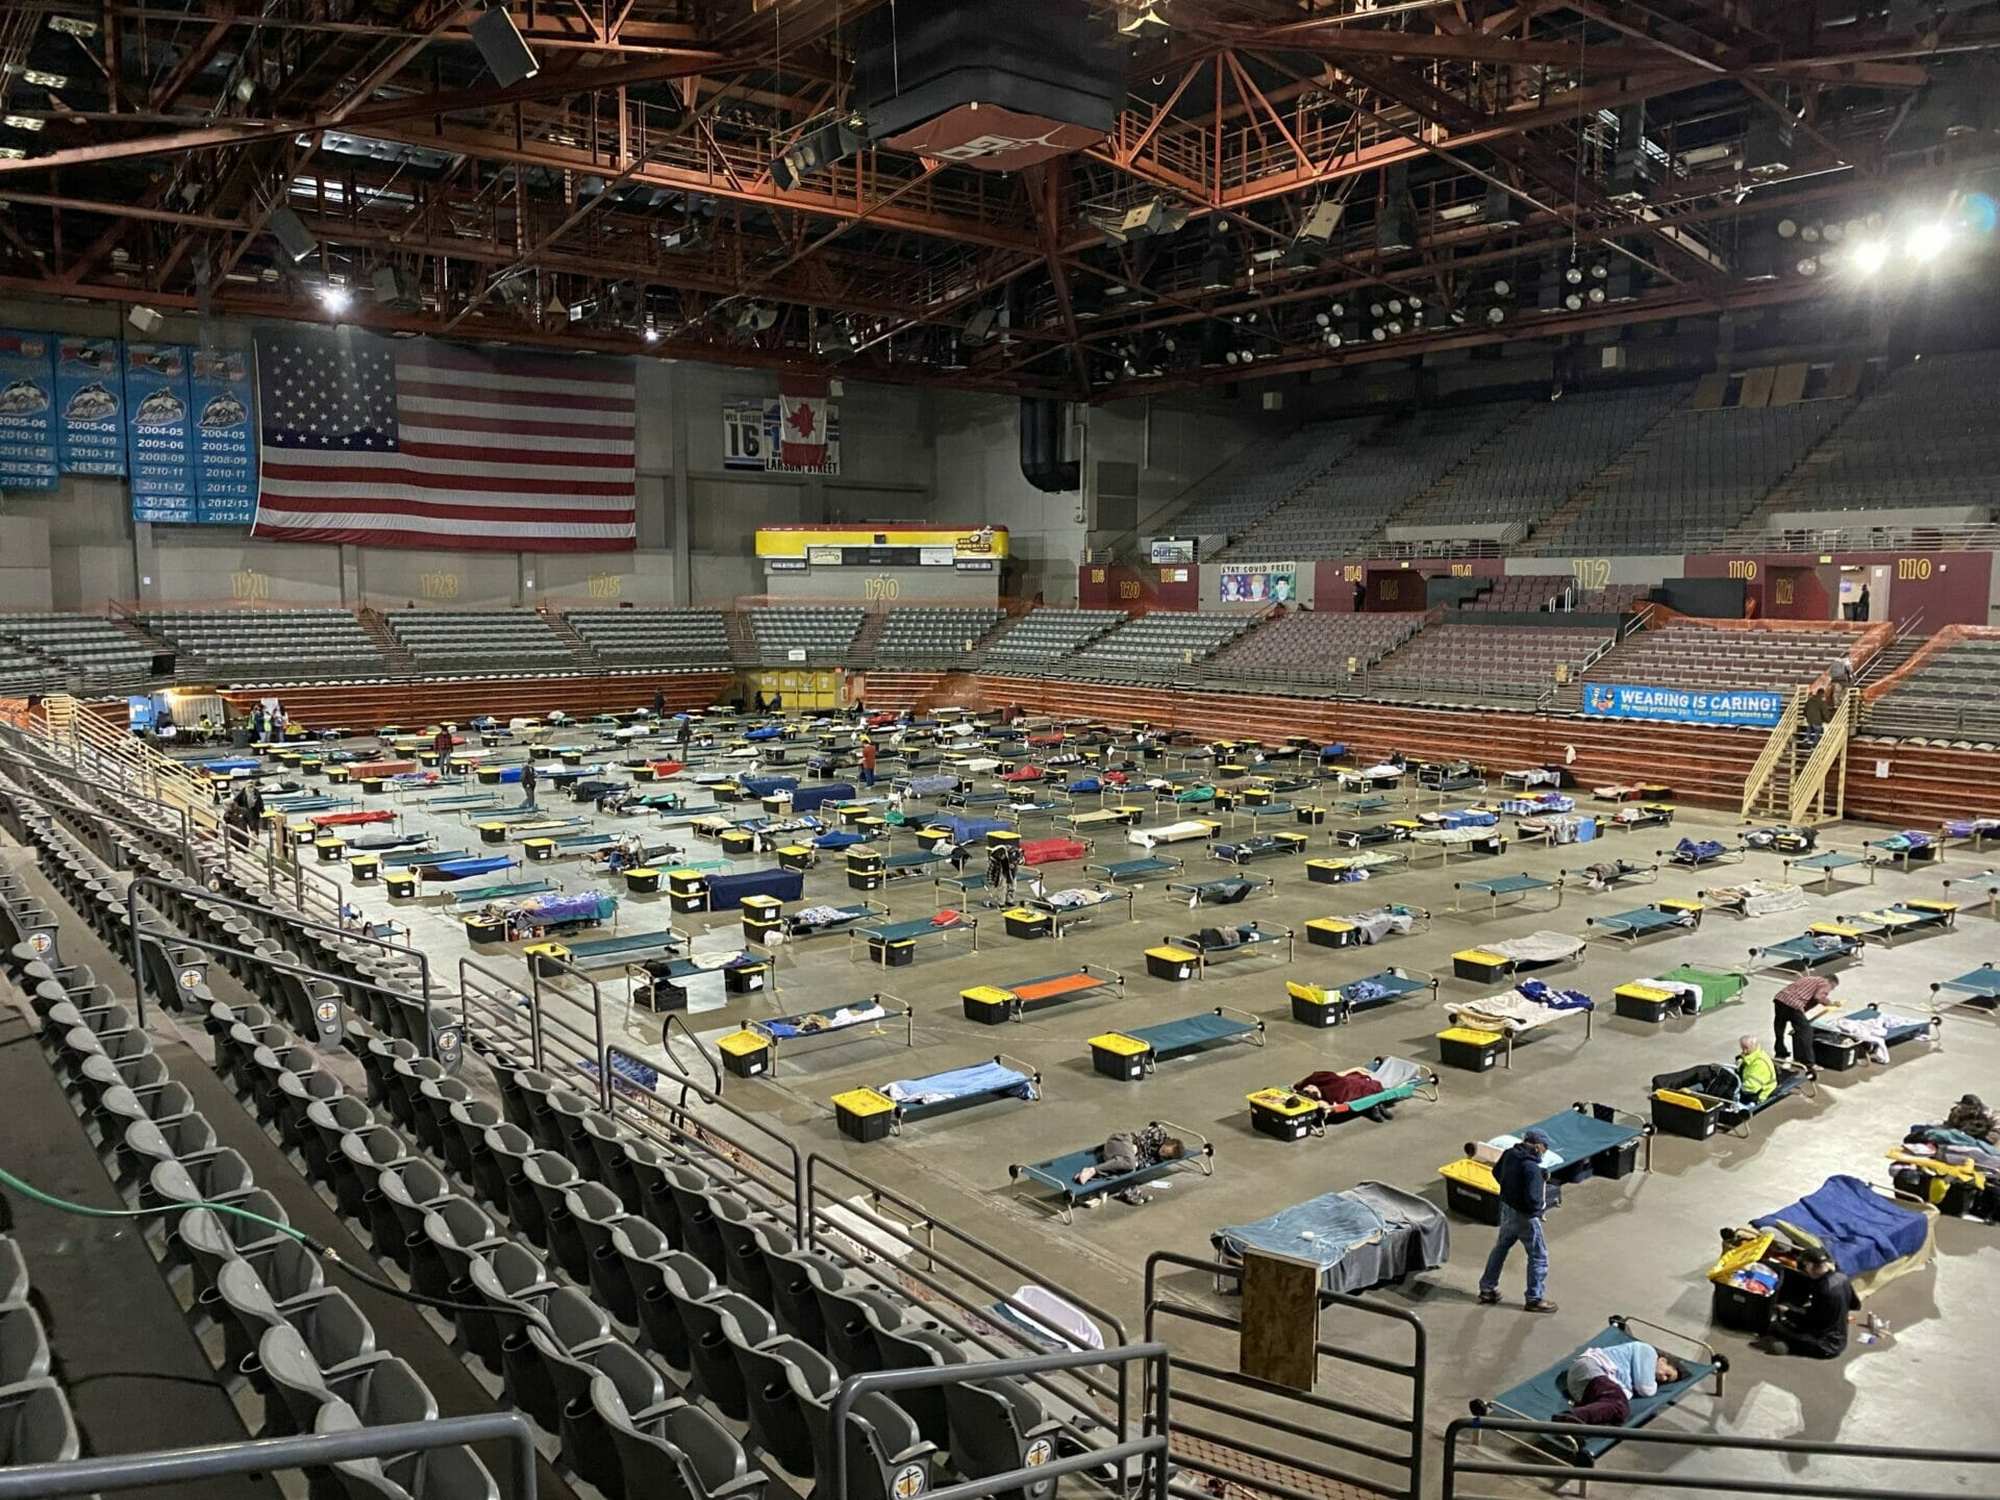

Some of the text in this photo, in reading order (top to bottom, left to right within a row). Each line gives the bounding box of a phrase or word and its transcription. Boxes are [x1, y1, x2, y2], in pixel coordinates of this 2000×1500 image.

[0, 416, 47, 428] 2005-06
[66, 420, 116, 432] 2005-06
[137, 425, 184, 437] 2004-05
[201, 428, 245, 440] 2004-05
[137, 438, 185, 450] 2005-06
[729, 423, 760, 457] 16
[71, 447, 115, 458] 2010-11
[201, 442, 246, 452] 2005-06
[206, 468, 246, 479] 2010-11
[209, 511, 250, 521] 2013-14
[1243, 564, 1267, 573] COVID
[1573, 559, 1610, 590] 112
[1729, 560, 1757, 580] 110
[1898, 558, 1932, 580] 110
[865, 578, 900, 600] 120
[1119, 580, 1140, 599] 120
[1620, 690, 1778, 712] WEARING IS CARING!
